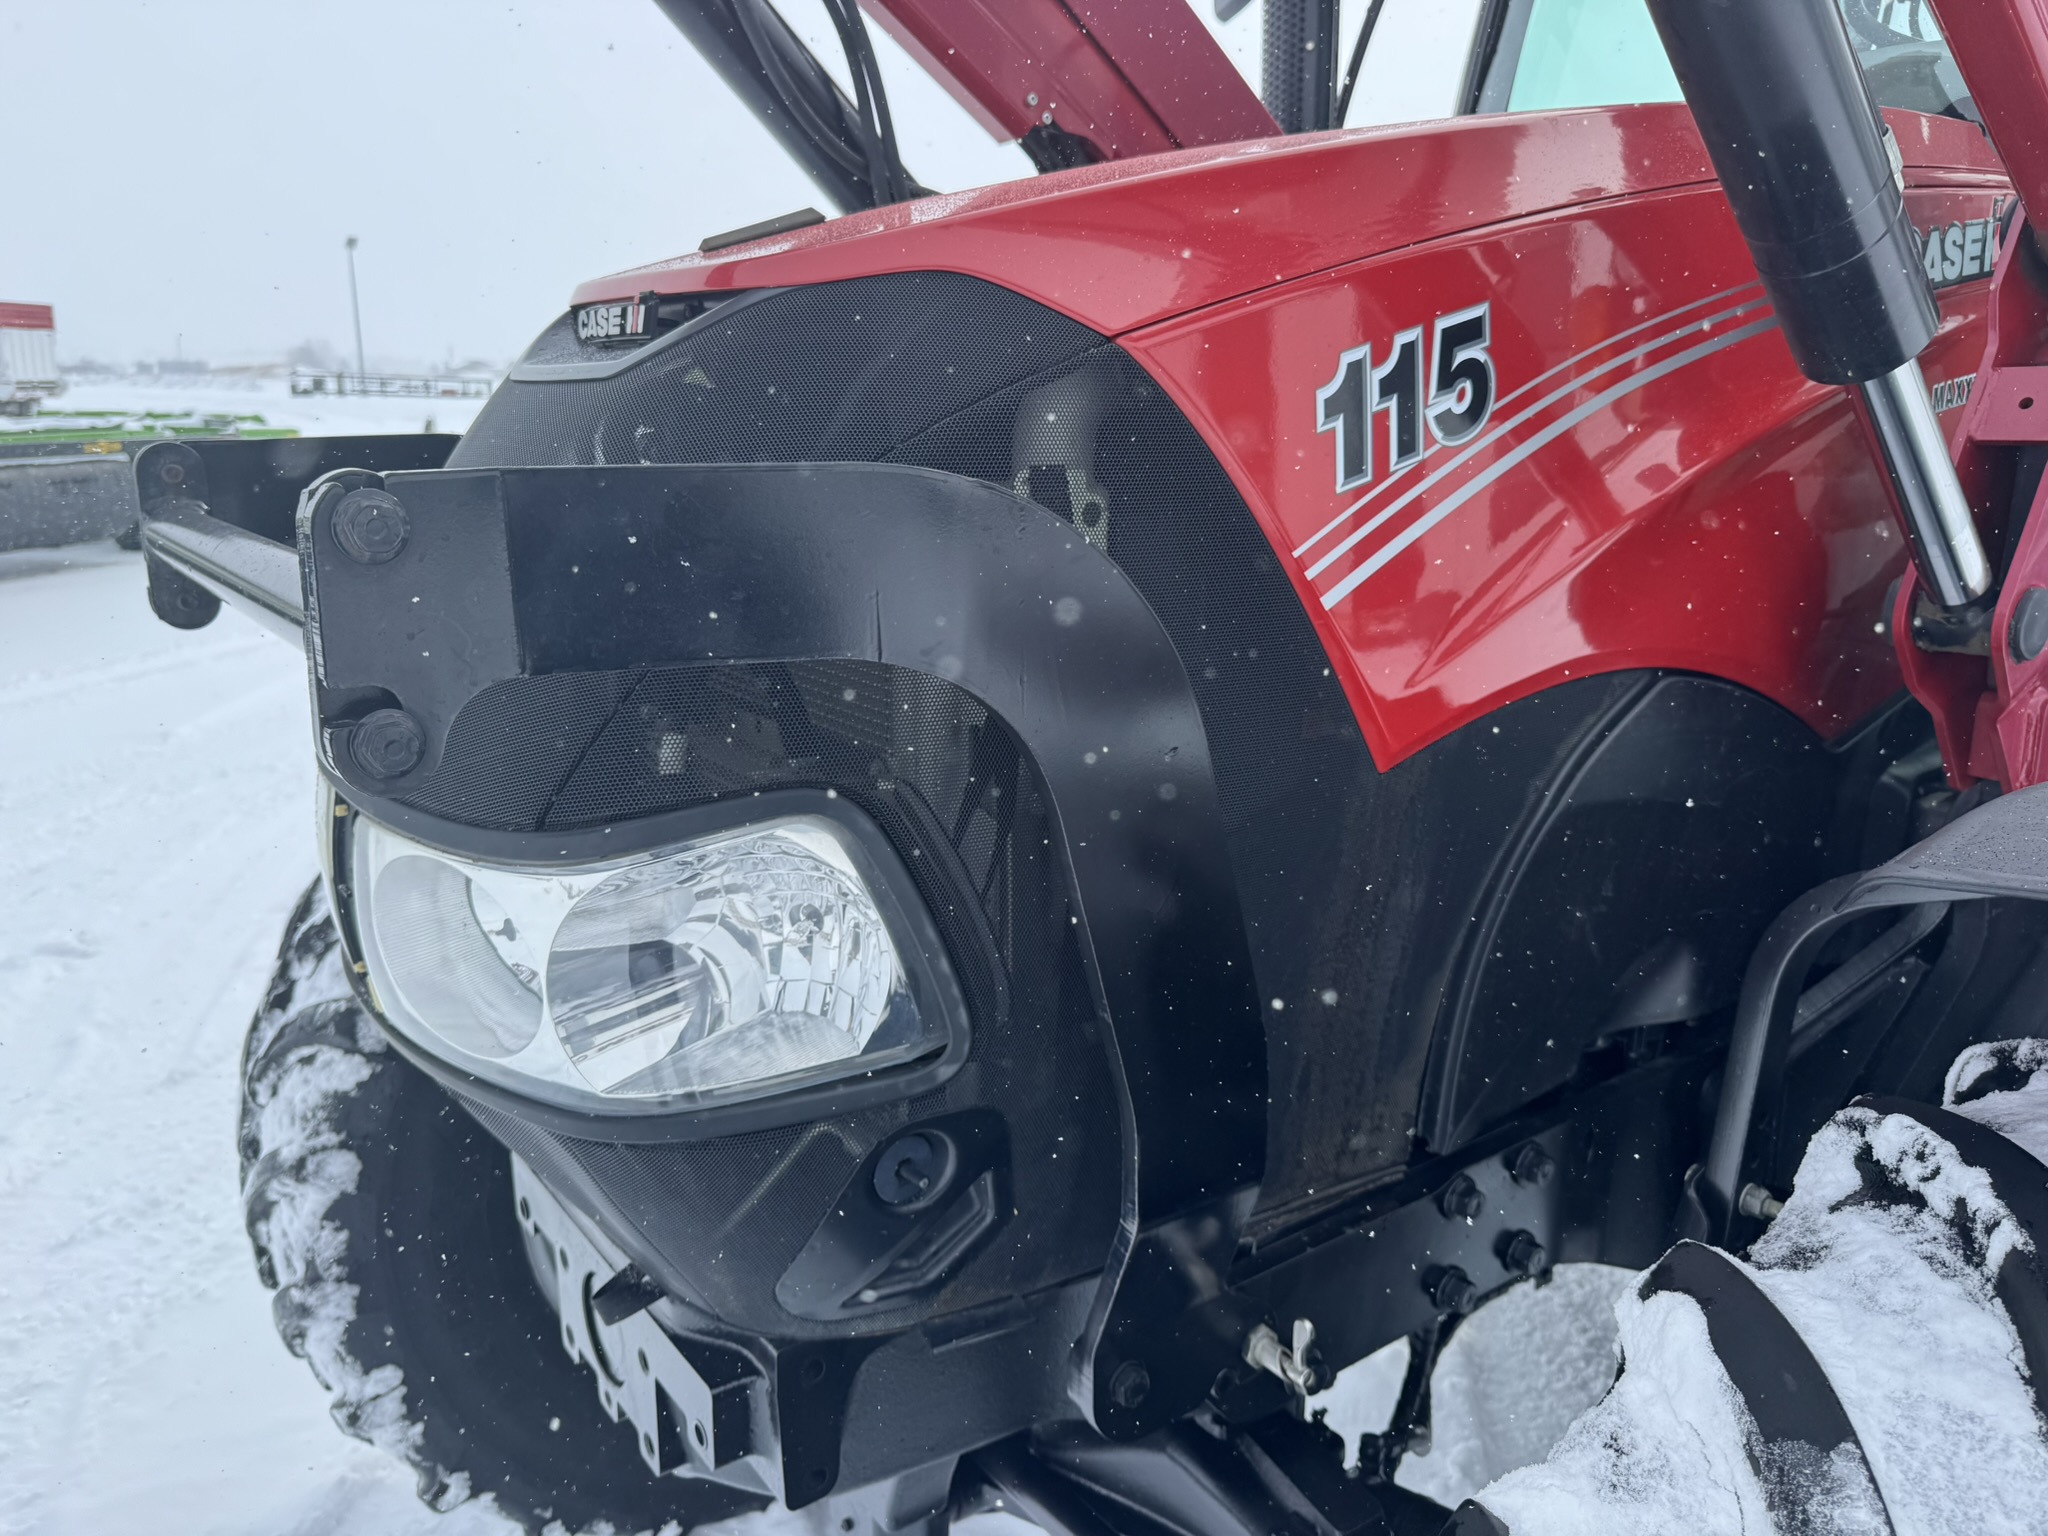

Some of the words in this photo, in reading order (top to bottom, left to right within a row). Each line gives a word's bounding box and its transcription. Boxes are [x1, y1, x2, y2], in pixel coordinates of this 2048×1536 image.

[578, 306, 622, 340] CASE
[1315, 300, 1496, 495] 115
[1932, 373, 1977, 414] MAXX
